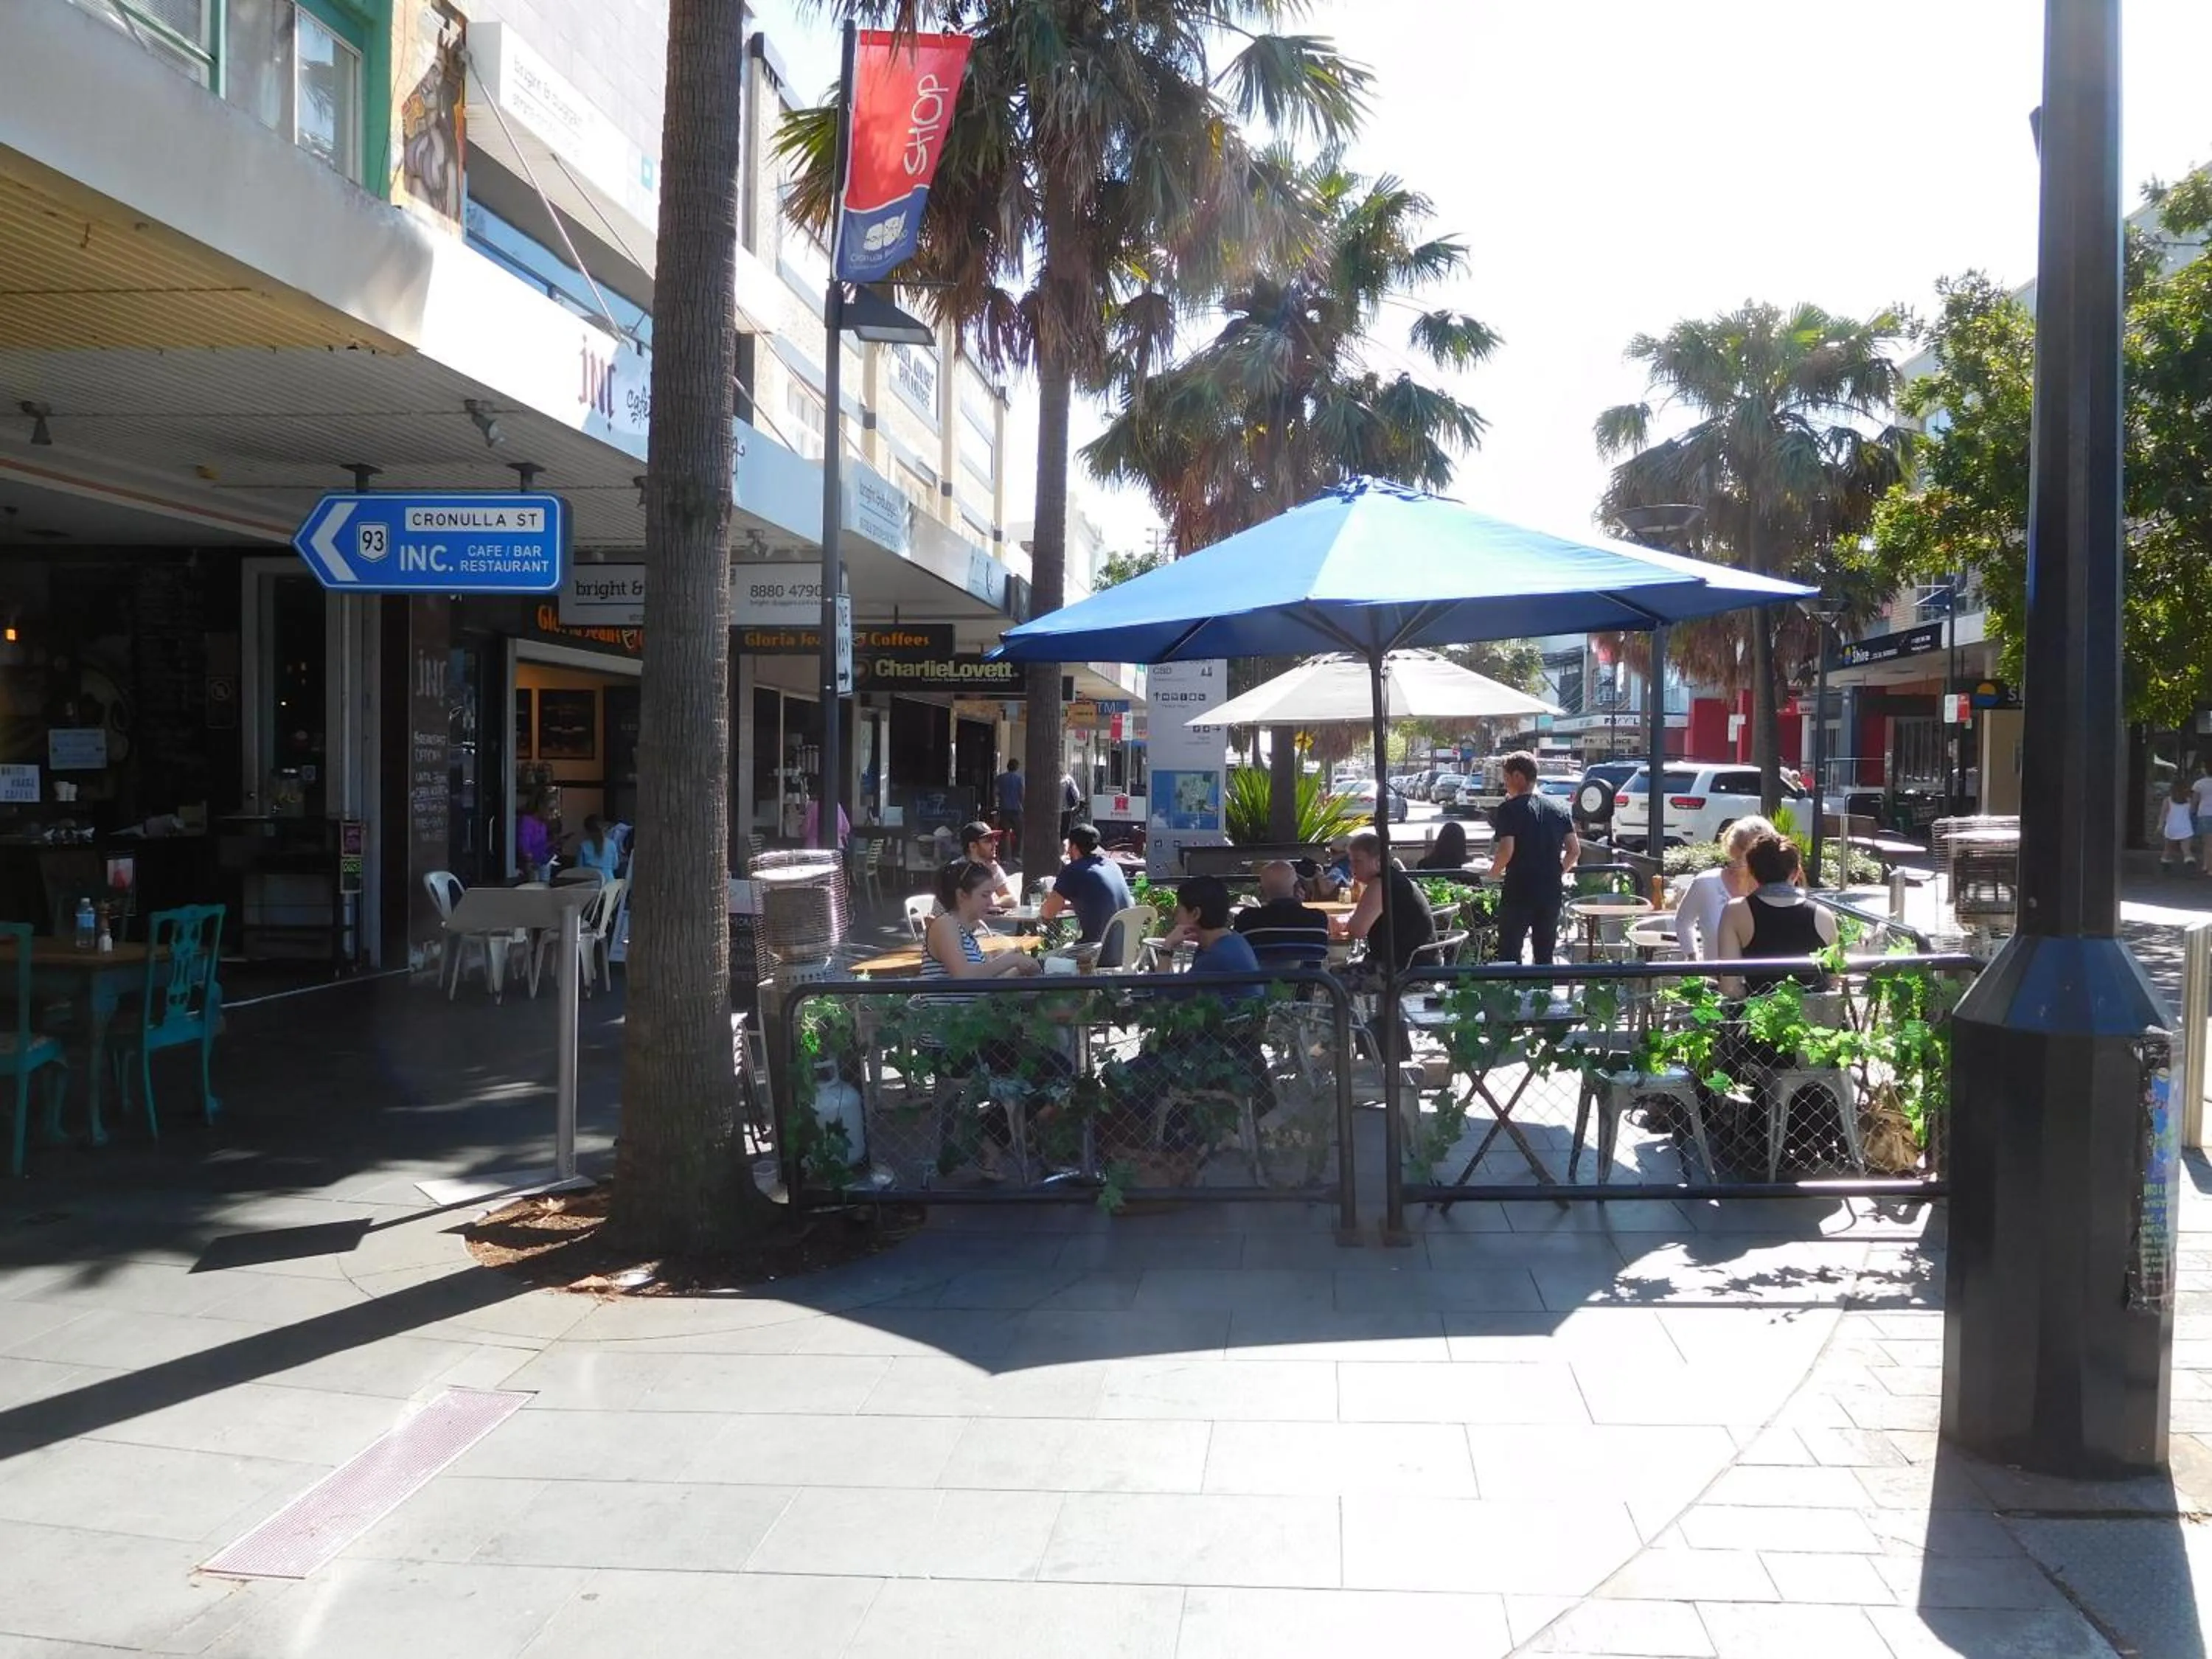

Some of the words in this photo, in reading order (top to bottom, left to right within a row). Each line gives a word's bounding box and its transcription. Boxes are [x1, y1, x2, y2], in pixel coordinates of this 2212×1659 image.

[903, 73, 950, 175] SHOP
[411, 512, 507, 526] CRONULLA
[516, 512, 538, 526] ST
[362, 529, 384, 552] 93
[400, 546, 454, 572] INC.
[467, 546, 502, 557] CAFE
[514, 546, 542, 557] BAR
[461, 560, 549, 573] RESTAURANT
[575, 580, 627, 599] bright
[632, 581, 643, 595] &
[750, 585, 785, 598] 8880
[745, 632, 796, 647] Gloria
[870, 630, 930, 647] Coffees
[875, 658, 1014, 678] CharlieLovett
[1096, 701, 1116, 714] TM
